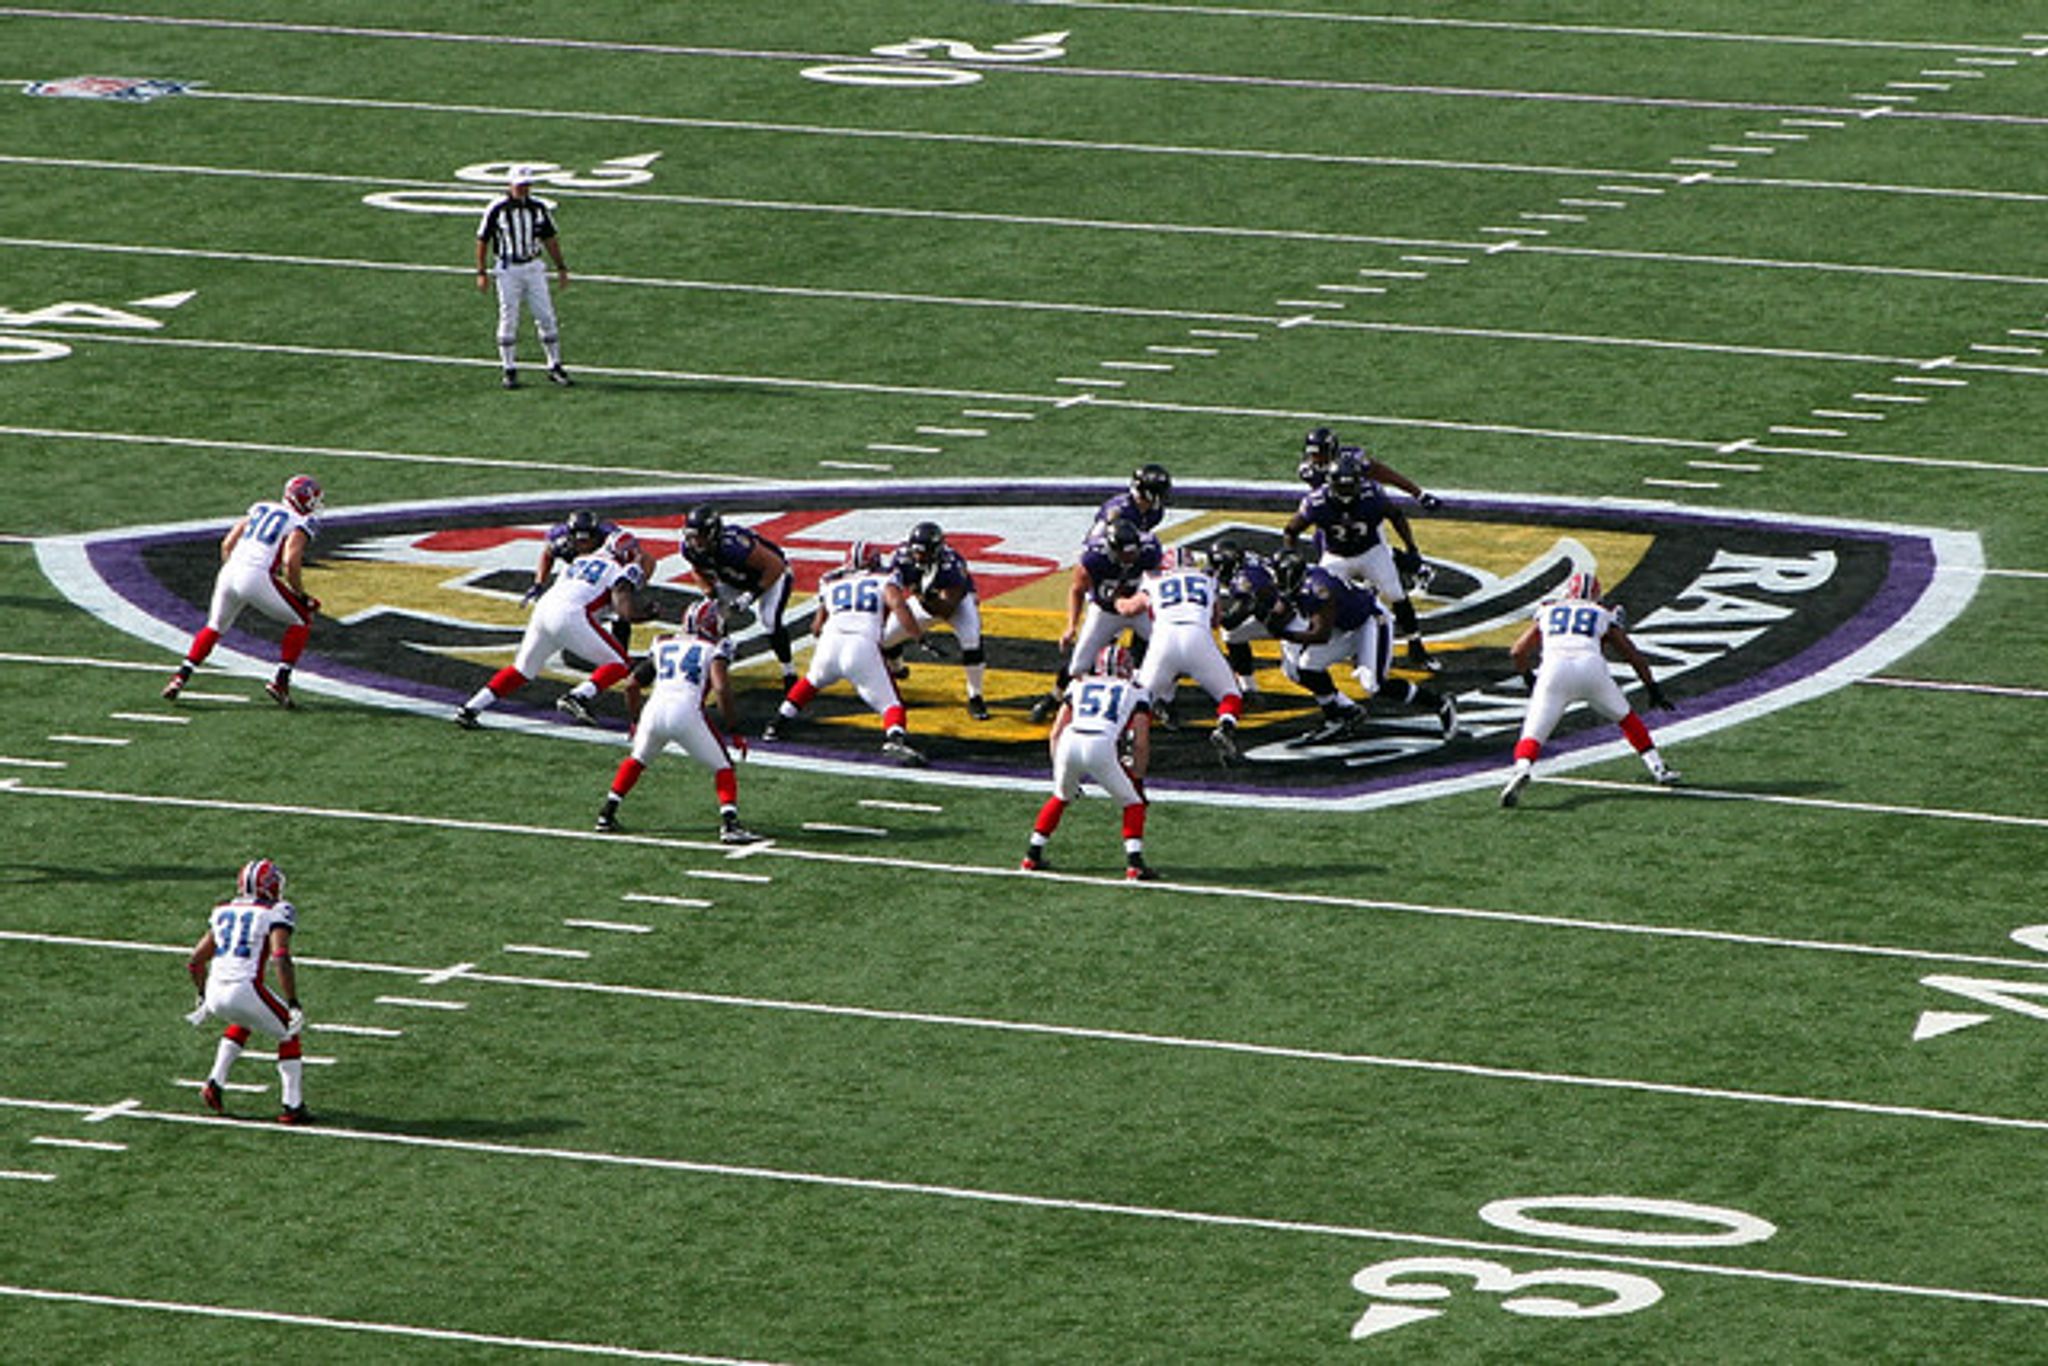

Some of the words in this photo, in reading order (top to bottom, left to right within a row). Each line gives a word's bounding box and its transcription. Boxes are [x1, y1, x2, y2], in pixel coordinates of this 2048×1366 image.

[832, 579, 879, 613] 96
[1160, 576, 1209, 608] 95
[1549, 607, 1599, 637] 98
[660, 645, 702, 685] 54
[1079, 684, 1123, 723] 51
[215, 911, 254, 958] 31
[1351, 1195, 1778, 1318] 30
